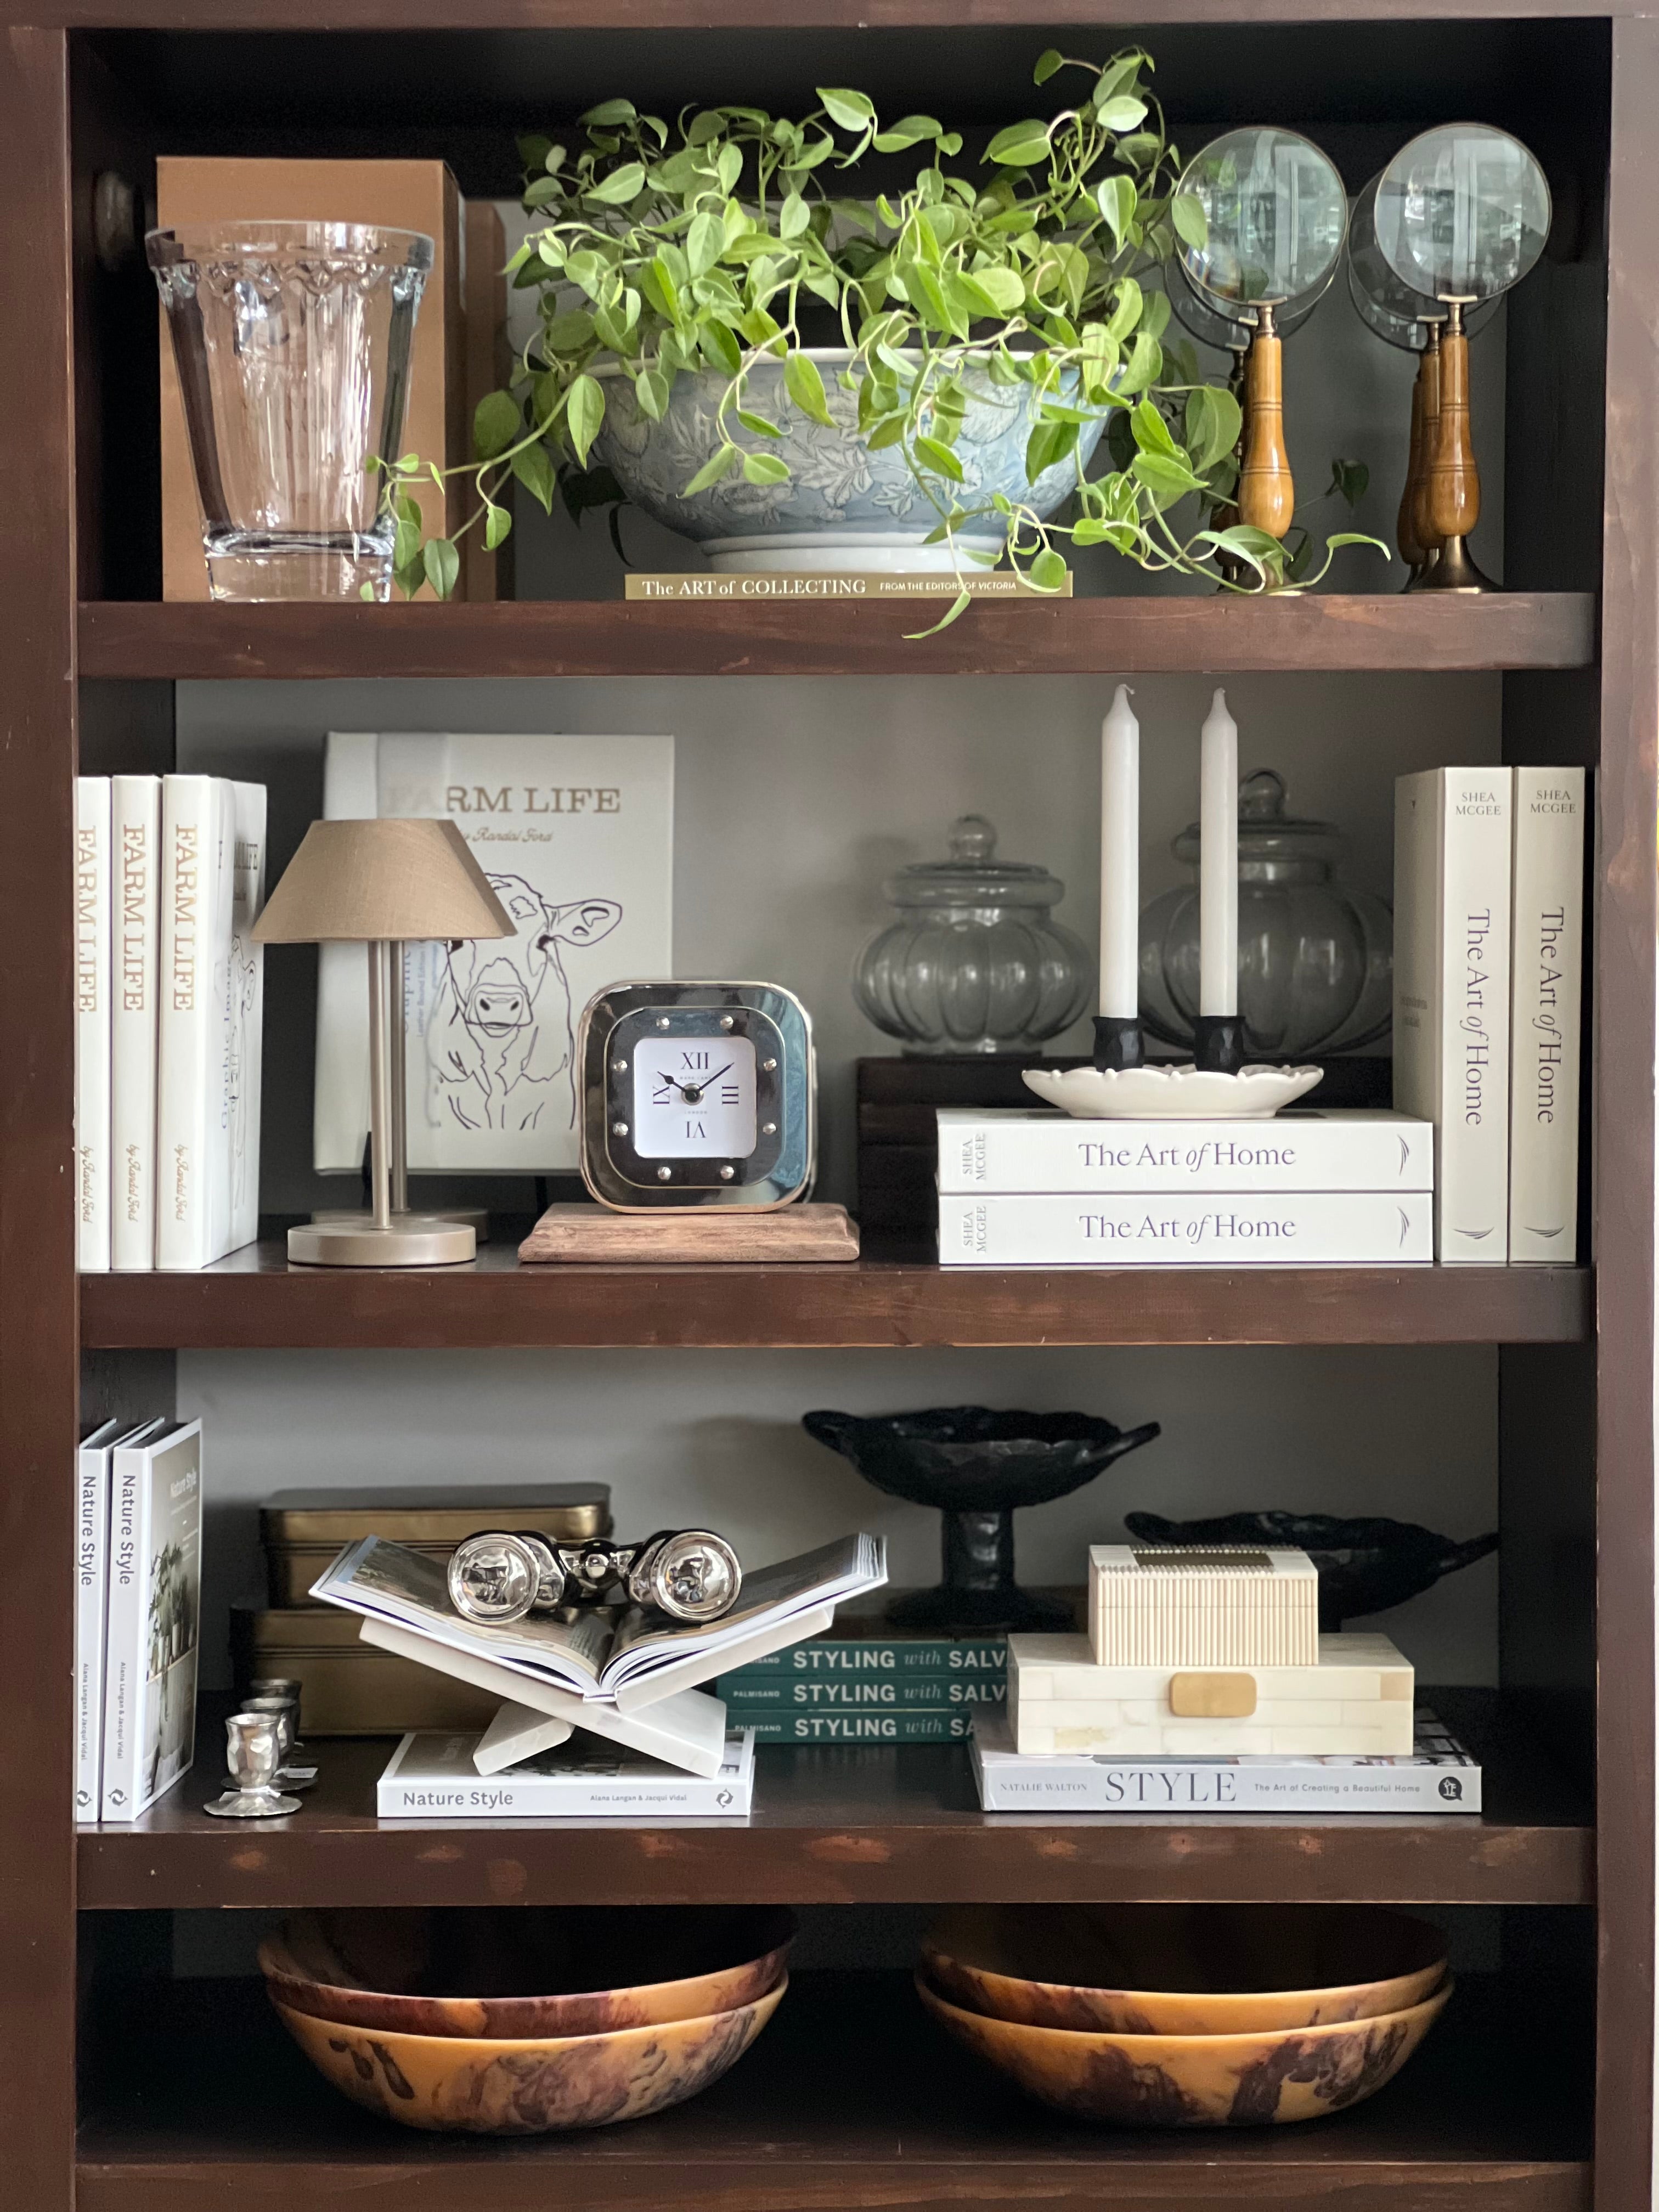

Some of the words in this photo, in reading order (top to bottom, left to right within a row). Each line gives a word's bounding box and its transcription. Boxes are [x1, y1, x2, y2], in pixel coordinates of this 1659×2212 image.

[642, 581, 673, 595] The
[679, 580, 716, 595] ART
[719, 580, 736, 595] of
[742, 579, 866, 595] COLLECTING
[880, 582, 905, 591] FROM
[907, 582, 923, 591] THE
[926, 582, 962, 591] EDITORS
[964, 582, 976, 590] OF
[978, 581, 1017, 590] VICTORIA
[446, 786, 512, 812] RM
[523, 787, 620, 814] LIFE
[1461, 792, 1496, 803] SHEA
[1530, 803, 1576, 814] MCGEE
[1536, 789, 1571, 800] SHEA
[1455, 805, 1501, 816] MCGEE
[472, 827, 522, 842] Randal
[522, 827, 554, 842] Ford
[123, 824, 146, 926] FARM
[175, 823, 198, 926] FARM
[1466, 909, 1490, 961] The
[1541, 906, 1564, 959] The
[123, 933, 144, 1011] LIFE
[173, 933, 195, 1011] LIFE
[1539, 964, 1563, 1007] Art
[1466, 966, 1489, 1009] Art
[1459, 1016, 1489, 1041] of
[1532, 1014, 1562, 1040] of
[680, 1052, 710, 1070] XII
[1466, 1044, 1489, 1126] Home
[1537, 1042, 1561, 1124] Home
[962, 1138, 973, 1175] SHEA
[975, 1133, 986, 1181] MCGEE
[1078, 1142, 1131, 1166] The
[1136, 1143, 1180, 1166] Art
[1186, 1142, 1211, 1172] of
[1213, 1142, 1296, 1166] Home
[82, 1159, 95, 1199] Randal
[128, 1157, 141, 1197] Randal
[176, 1157, 189, 1197] Randal
[82, 1198, 94, 1223] Ford
[127, 1197, 140, 1222] Ford
[175, 1197, 188, 1222] Ford
[963, 1211, 973, 1246] SHEA
[976, 1205, 987, 1253] MCGEE
[1079, 1215, 1132, 1238] The
[1136, 1215, 1180, 1238] Art
[1187, 1215, 1211, 1245] of
[1214, 1215, 1297, 1237] Home
[82, 1476, 97, 1537] Nature
[121, 1475, 136, 1536] Nature
[78, 1542, 96, 1586] Style
[116, 1542, 134, 1585] Style
[793, 1650, 895, 1668] STYLING
[904, 1650, 942, 1666] with
[949, 1650, 1008, 1668] SALV
[793, 1684, 895, 1702] STYLING
[904, 1684, 942, 1700] with
[795, 1719, 897, 1736] STYLING
[905, 1718, 943, 1734] with
[403, 1791, 465, 1806] Nature
[470, 1790, 514, 1809] Style
[645, 1795, 668, 1803] Jacqui
[1000, 1783, 1042, 1791] NATALIE
[1045, 1783, 1088, 1791] WALTON
[1105, 1771, 1237, 1802] STYLE
[1254, 1783, 1270, 1791] The
[1301, 1784, 1340, 1794] Creating
[1352, 1784, 1391, 1792] Beautiful
